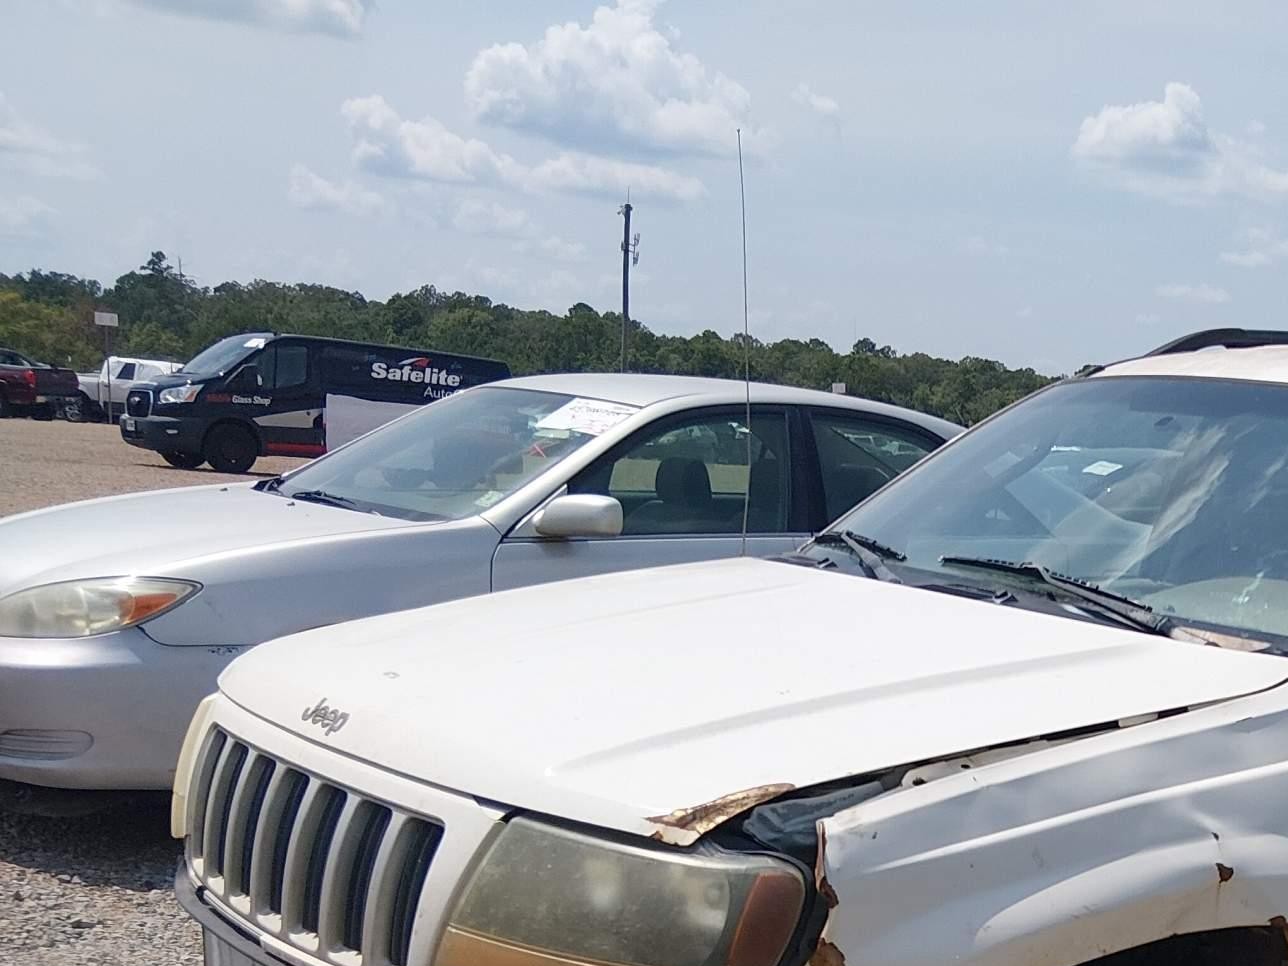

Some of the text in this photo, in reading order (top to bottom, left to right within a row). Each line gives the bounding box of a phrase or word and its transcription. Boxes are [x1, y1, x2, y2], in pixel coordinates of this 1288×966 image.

[370, 361, 462, 387] Safelite
[231, 394, 252, 404] Glass
[252, 395, 272, 407] Shop
[302, 697, 350, 737] Jeep
